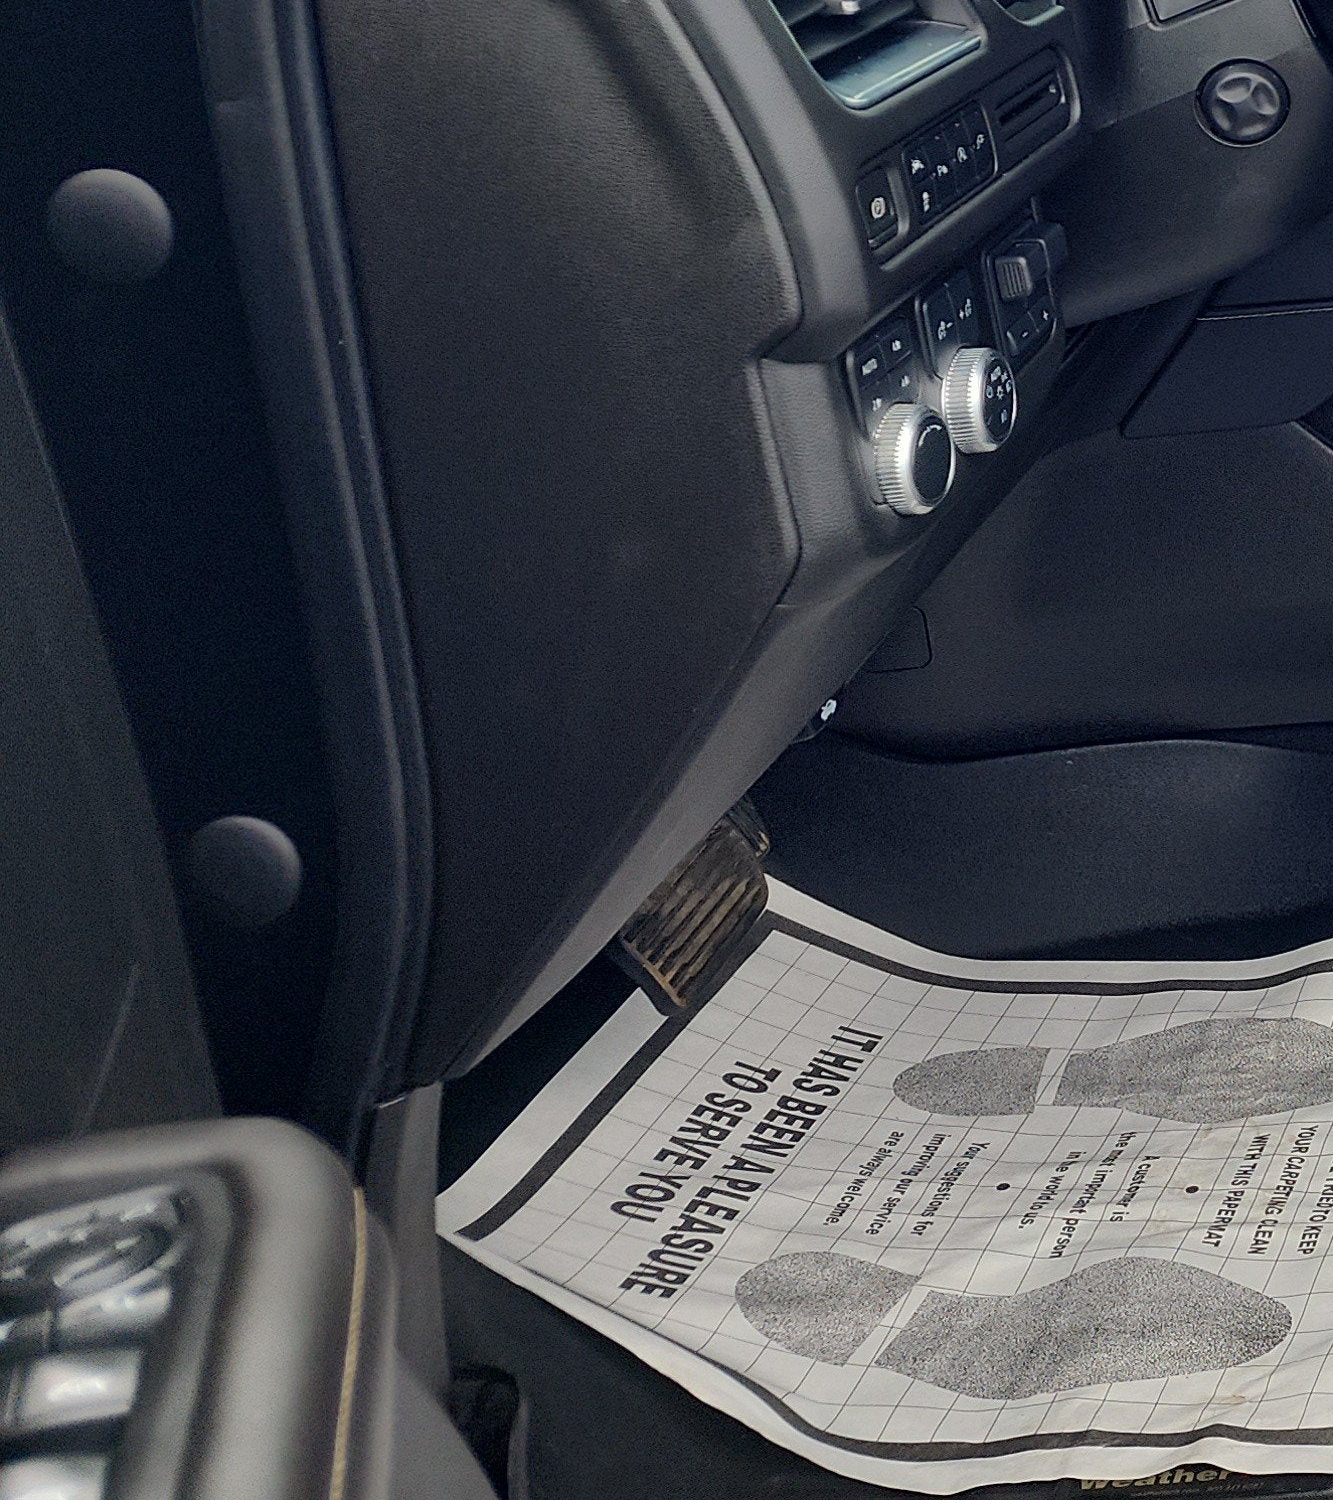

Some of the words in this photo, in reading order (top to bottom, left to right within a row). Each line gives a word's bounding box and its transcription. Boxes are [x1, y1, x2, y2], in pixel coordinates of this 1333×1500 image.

[830, 1025, 884, 1053] IT
[721, 1060, 782, 1094] TO
[792, 1049, 865, 1098] HAS
[653, 1092, 753, 1171] SERVE
[741, 1094, 828, 1158] BEEN
[884, 1131, 905, 1147] are
[1115, 1131, 1137, 1148] the
[1293, 1125, 1319, 1154] YOUR
[901, 1133, 952, 1177] improving
[961, 1142, 991, 1160] Your
[1066, 1151, 1086, 1161] in
[1244, 1133, 1271, 1161] WITH
[721, 1154, 776, 1175] A
[857, 1147, 893, 1177] always
[1231, 1162, 1258, 1186] THIS
[610, 1171, 693, 1223] YOU
[892, 1178, 914, 1195] our
[921, 1161, 970, 1218] suggestions
[1037, 1175, 1065, 1201] world
[1116, 1163, 1151, 1208] customer
[1265, 1156, 1305, 1216] CARPETING
[822, 1177, 868, 1227] welcome.
[865, 1196, 901, 1236] service
[1030, 1200, 1048, 1211] to
[1109, 1211, 1130, 1222] is
[1309, 1208, 1331, 1223] TO
[910, 1220, 934, 1236] for
[1018, 1211, 1038, 1229] us.
[618, 1174, 763, 1299] PLEASURE
[1049, 1217, 1079, 1259] person
[1247, 1218, 1279, 1255] CLEAN
[1297, 1224, 1323, 1255] KEEP
